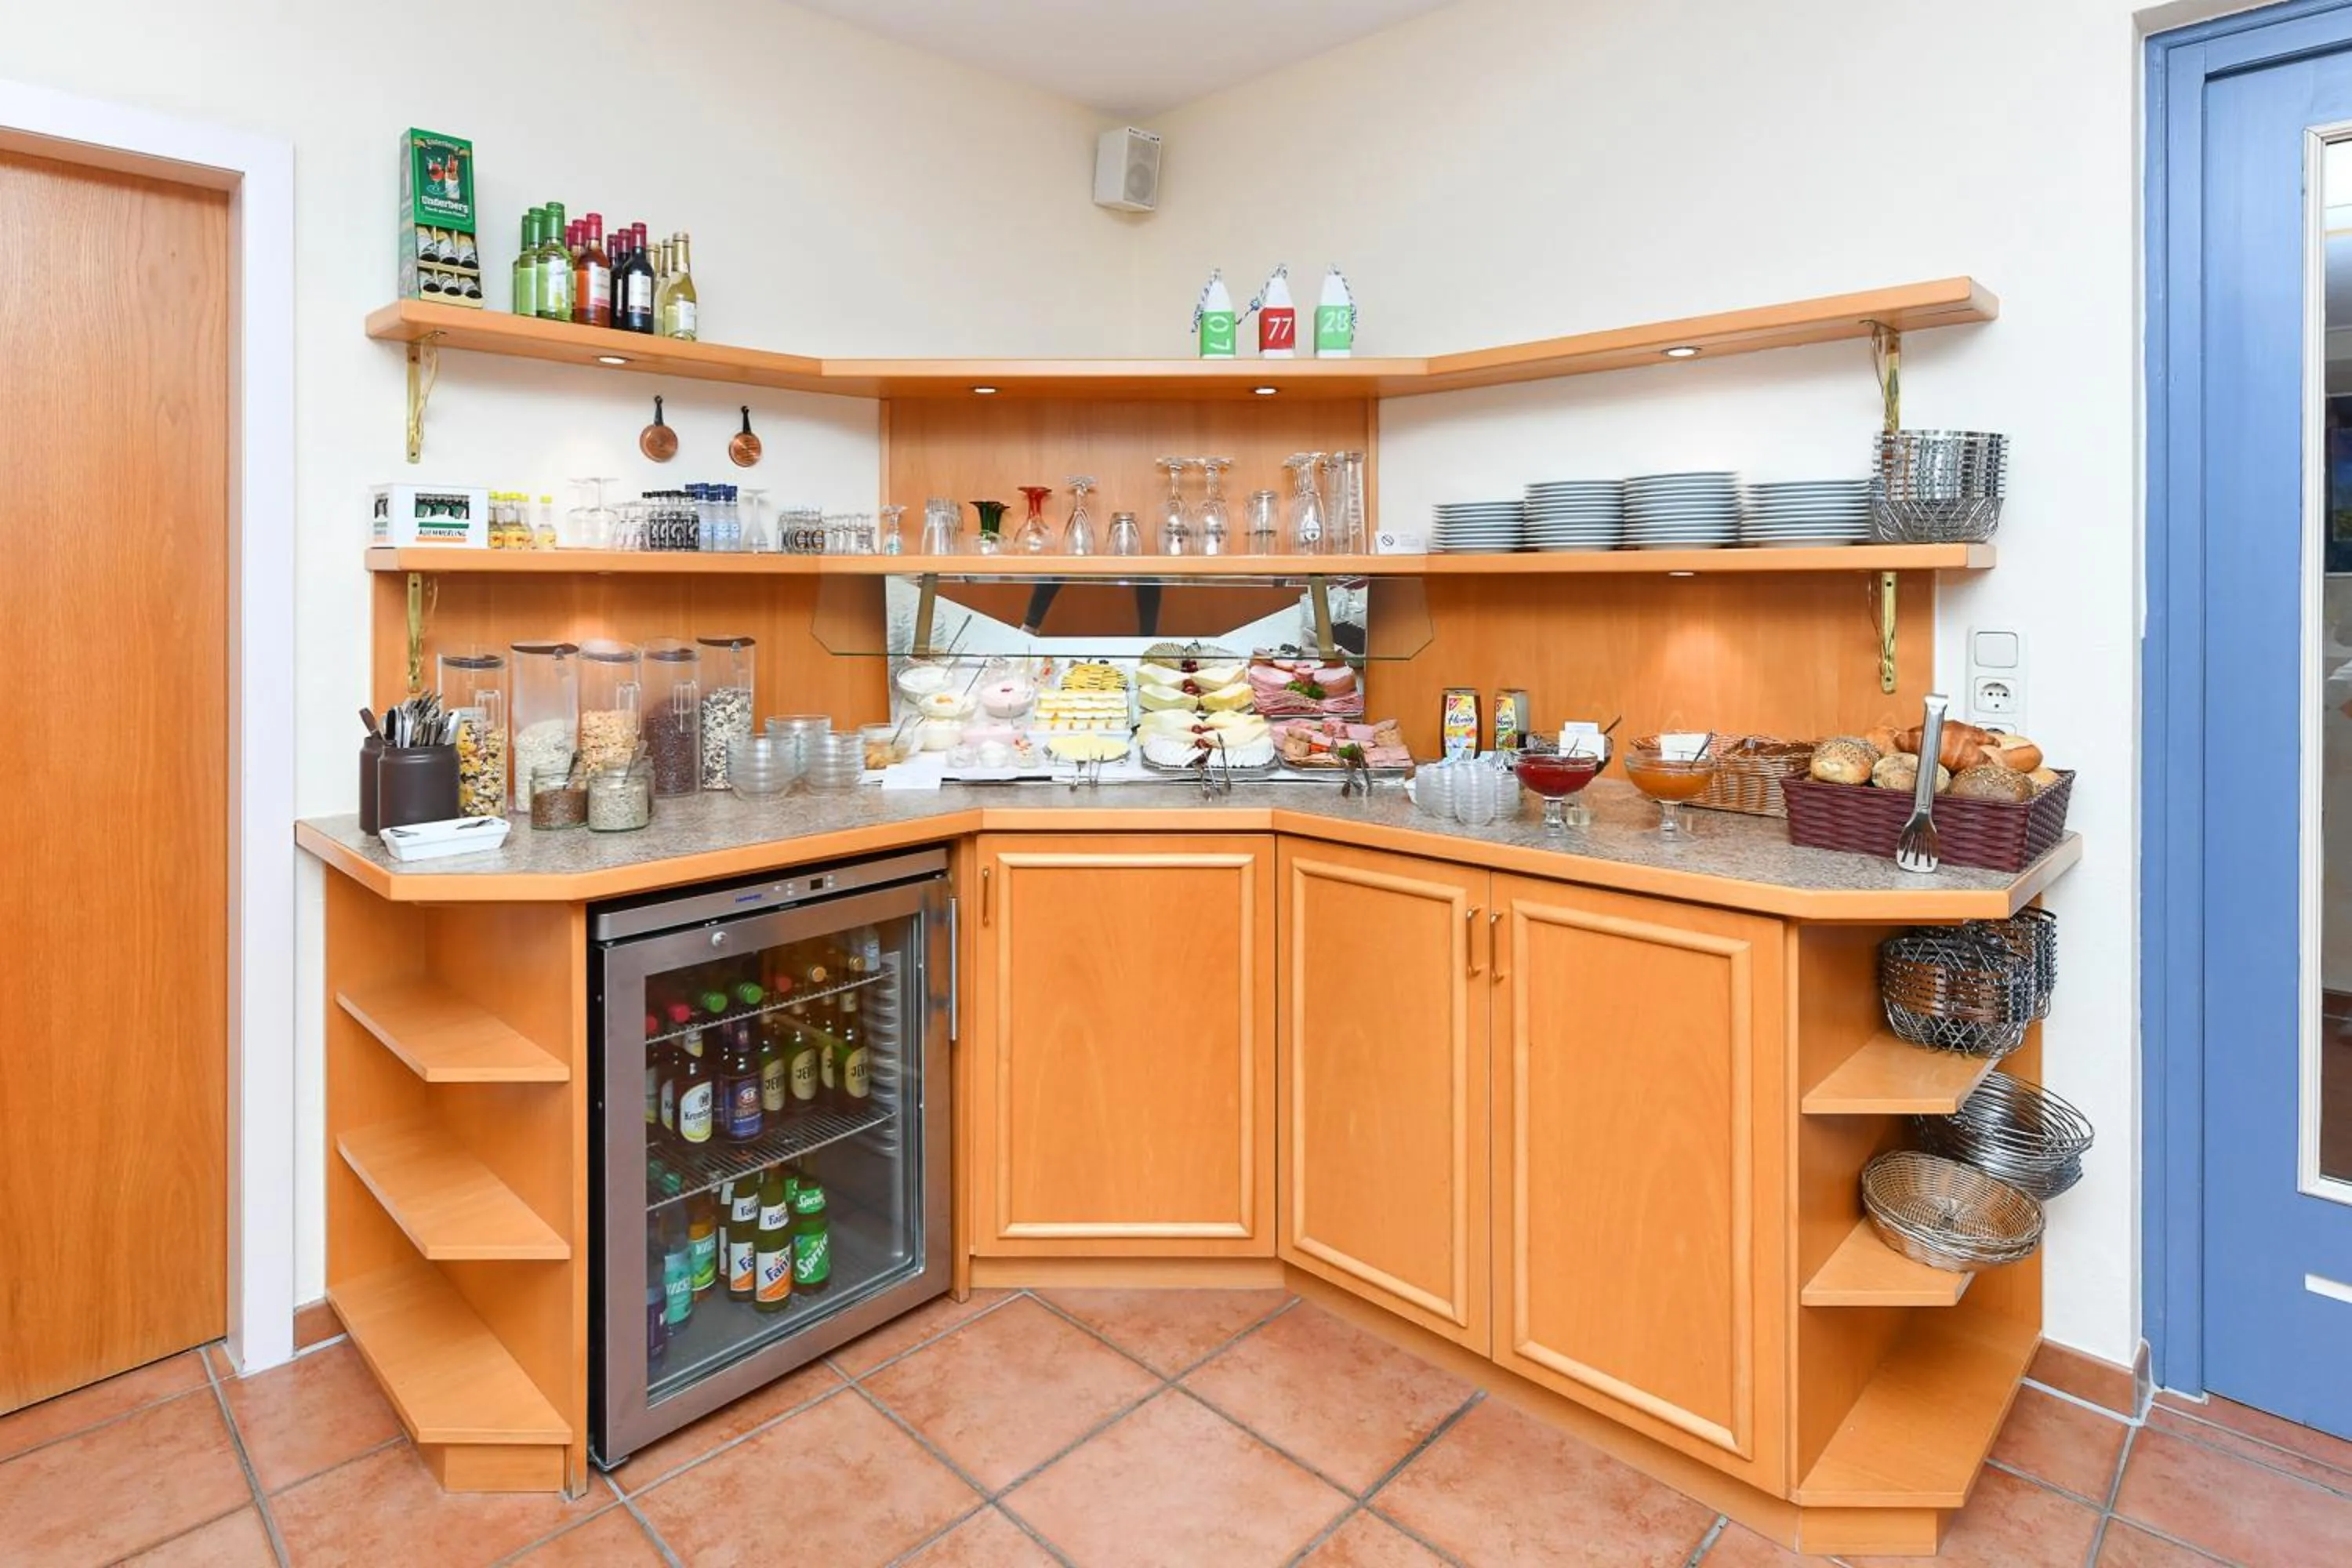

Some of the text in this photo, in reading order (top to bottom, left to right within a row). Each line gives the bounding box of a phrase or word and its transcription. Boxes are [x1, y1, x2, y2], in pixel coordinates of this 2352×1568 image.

[421, 195, 469, 214] Underberg
[1268, 317, 1293, 340] 77
[1321, 310, 1349, 332] 28
